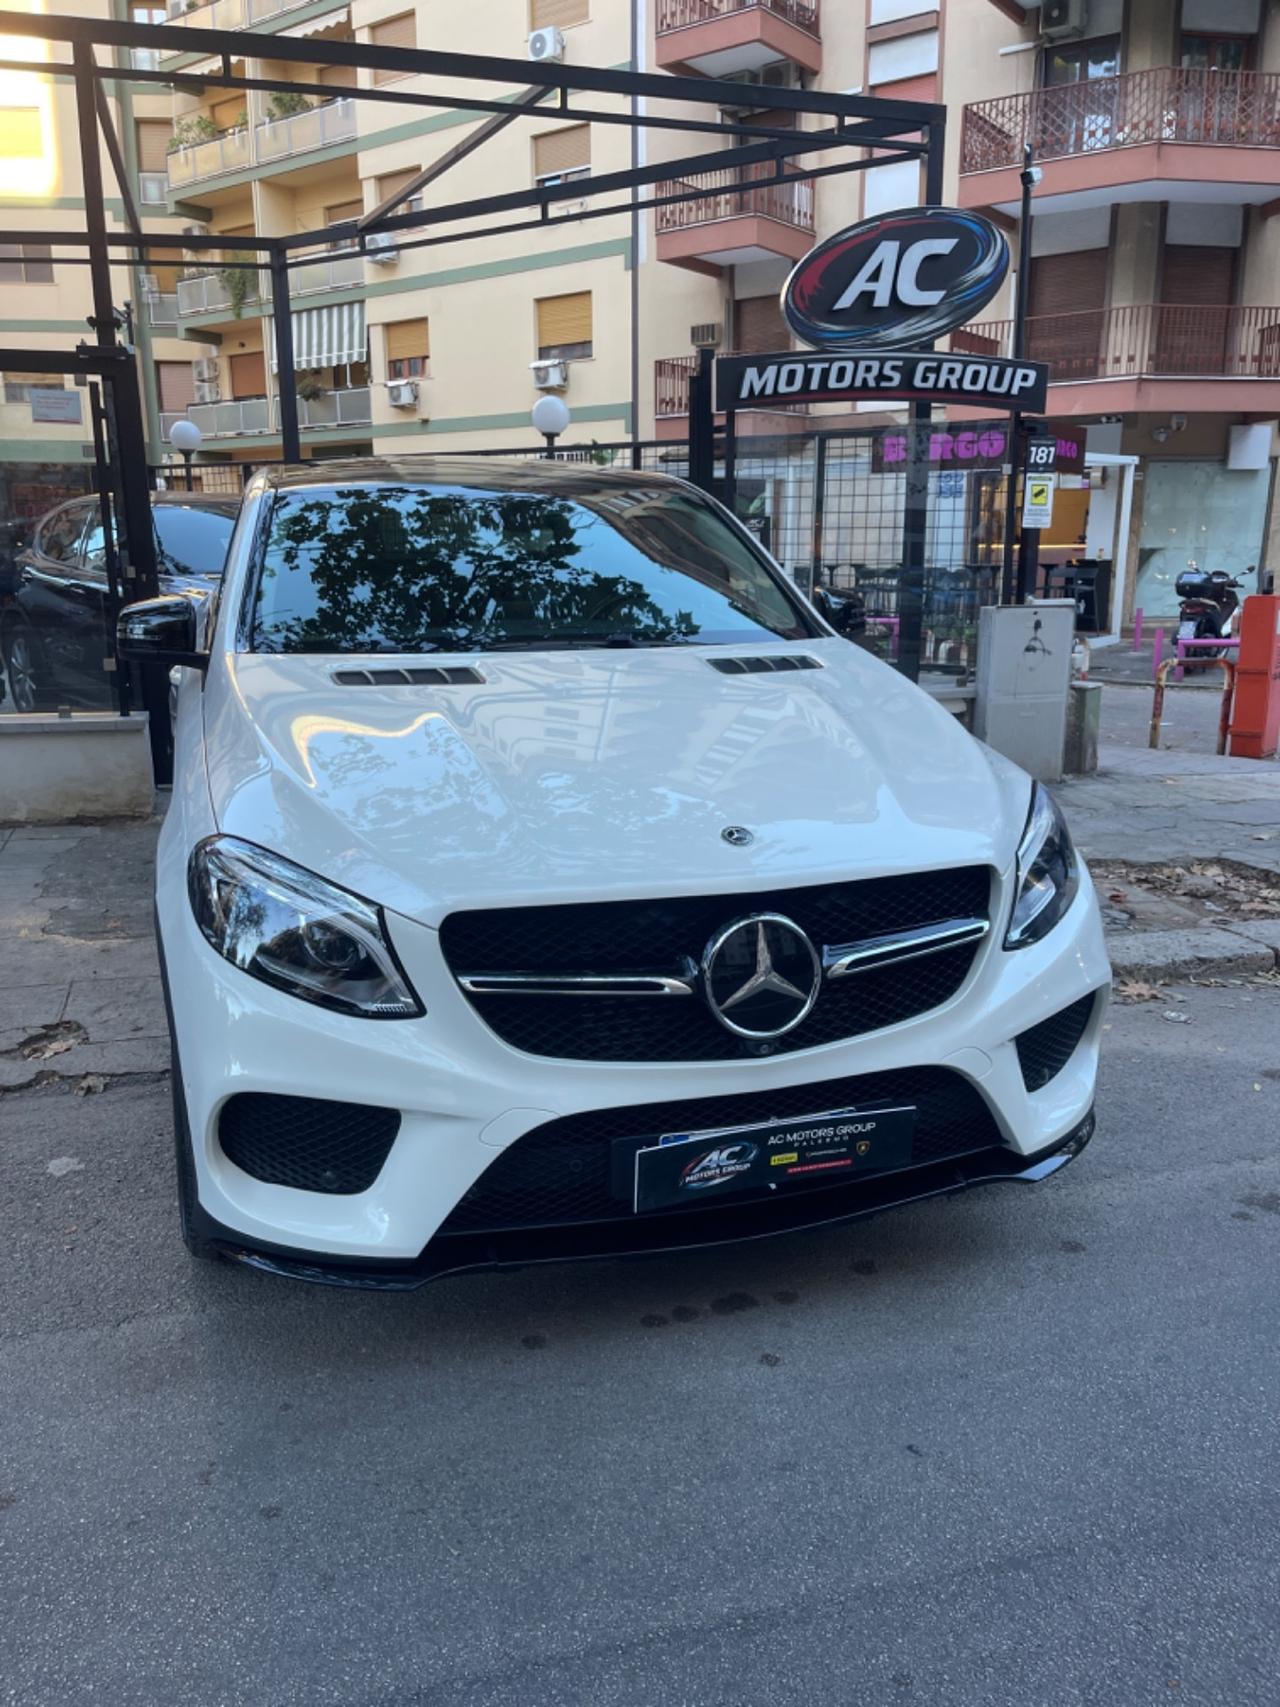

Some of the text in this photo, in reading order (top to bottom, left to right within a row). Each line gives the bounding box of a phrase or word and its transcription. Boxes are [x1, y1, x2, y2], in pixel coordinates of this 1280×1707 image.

[832, 238, 960, 310] AC
[740, 360, 1037, 399] MOTORS GROUP
[883, 430, 1005, 462] BRGO
[1030, 446, 1056, 464] 181
[768, 1122, 876, 1145] AC MOTORS GROUP
[685, 1163, 751, 1183] MOTORS GROUP
[691, 1146, 743, 1174] AC
